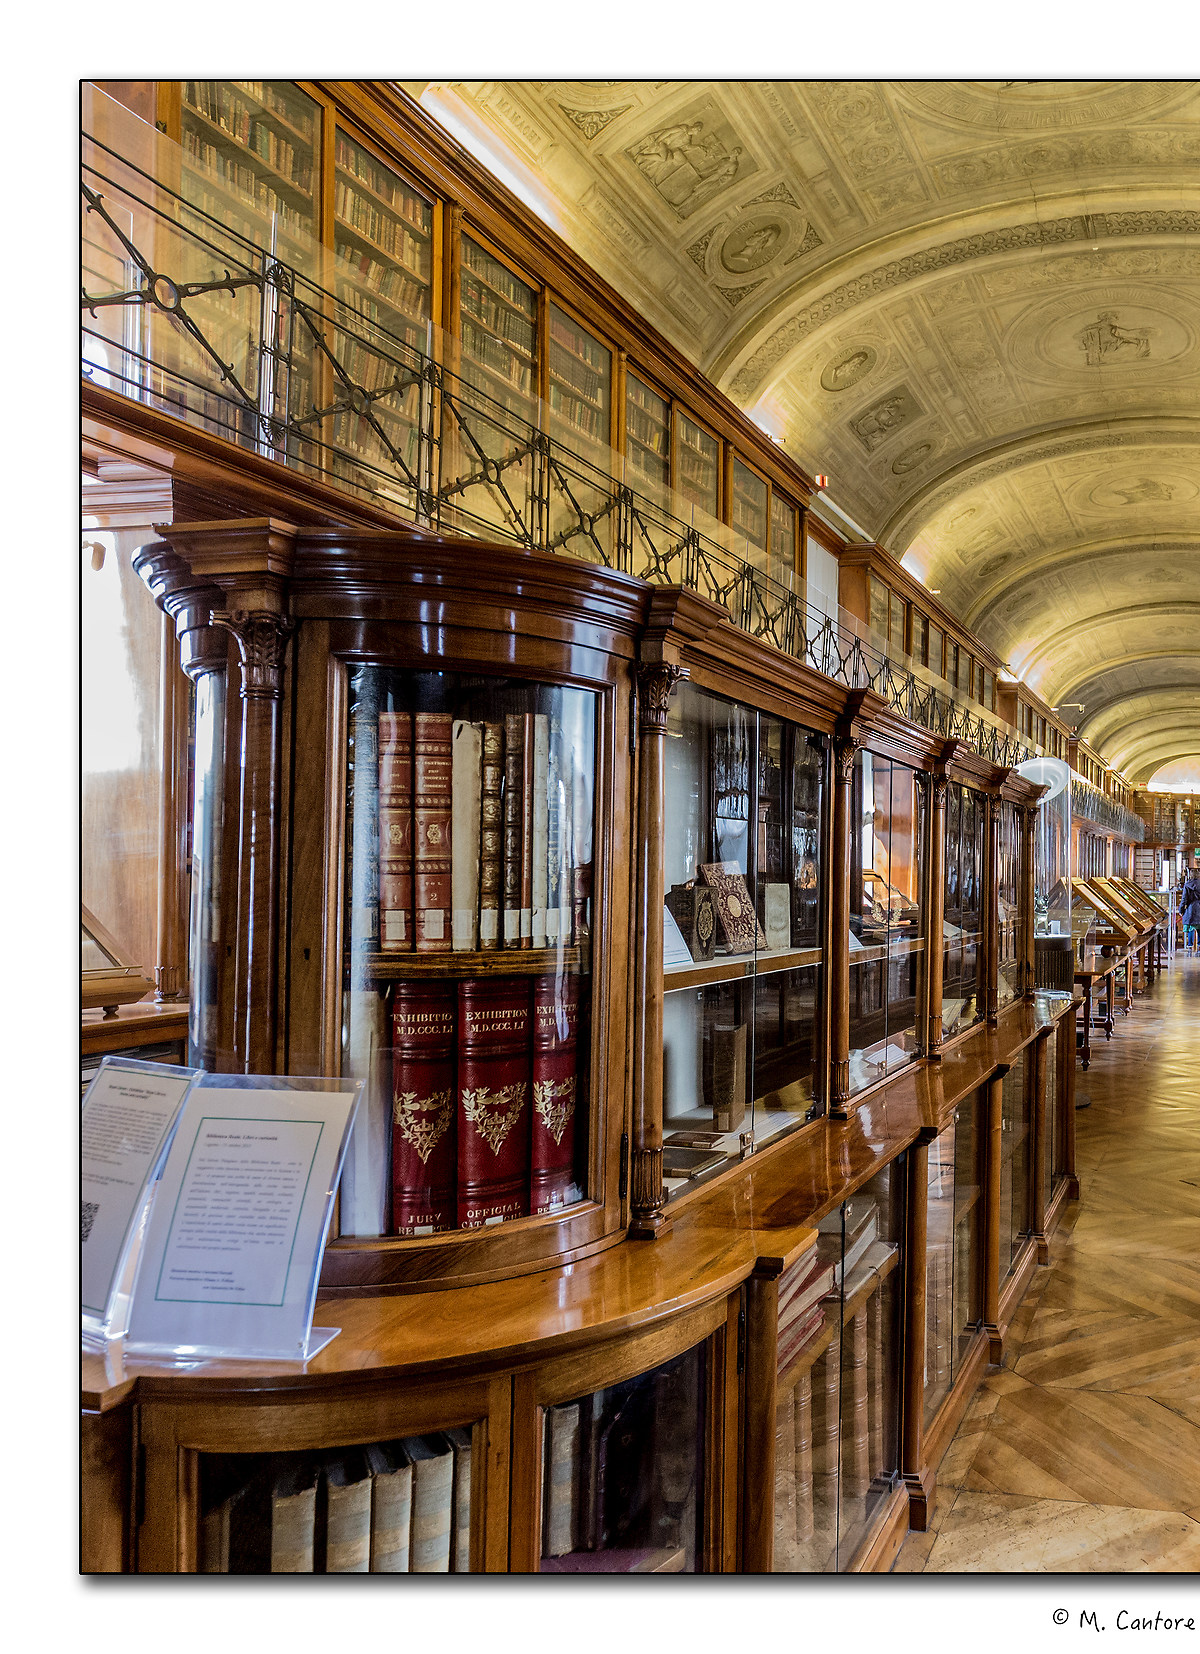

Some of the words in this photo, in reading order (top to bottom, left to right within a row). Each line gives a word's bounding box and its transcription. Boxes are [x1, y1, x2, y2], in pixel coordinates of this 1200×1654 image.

[430, 892, 438, 901] 2
[393, 1013, 453, 1022] EXHIBITIO
[466, 1009, 528, 1021] EXHIBITION
[467, 1201, 521, 1219] OFFICIAL
[407, 1212, 441, 1224] JURY
